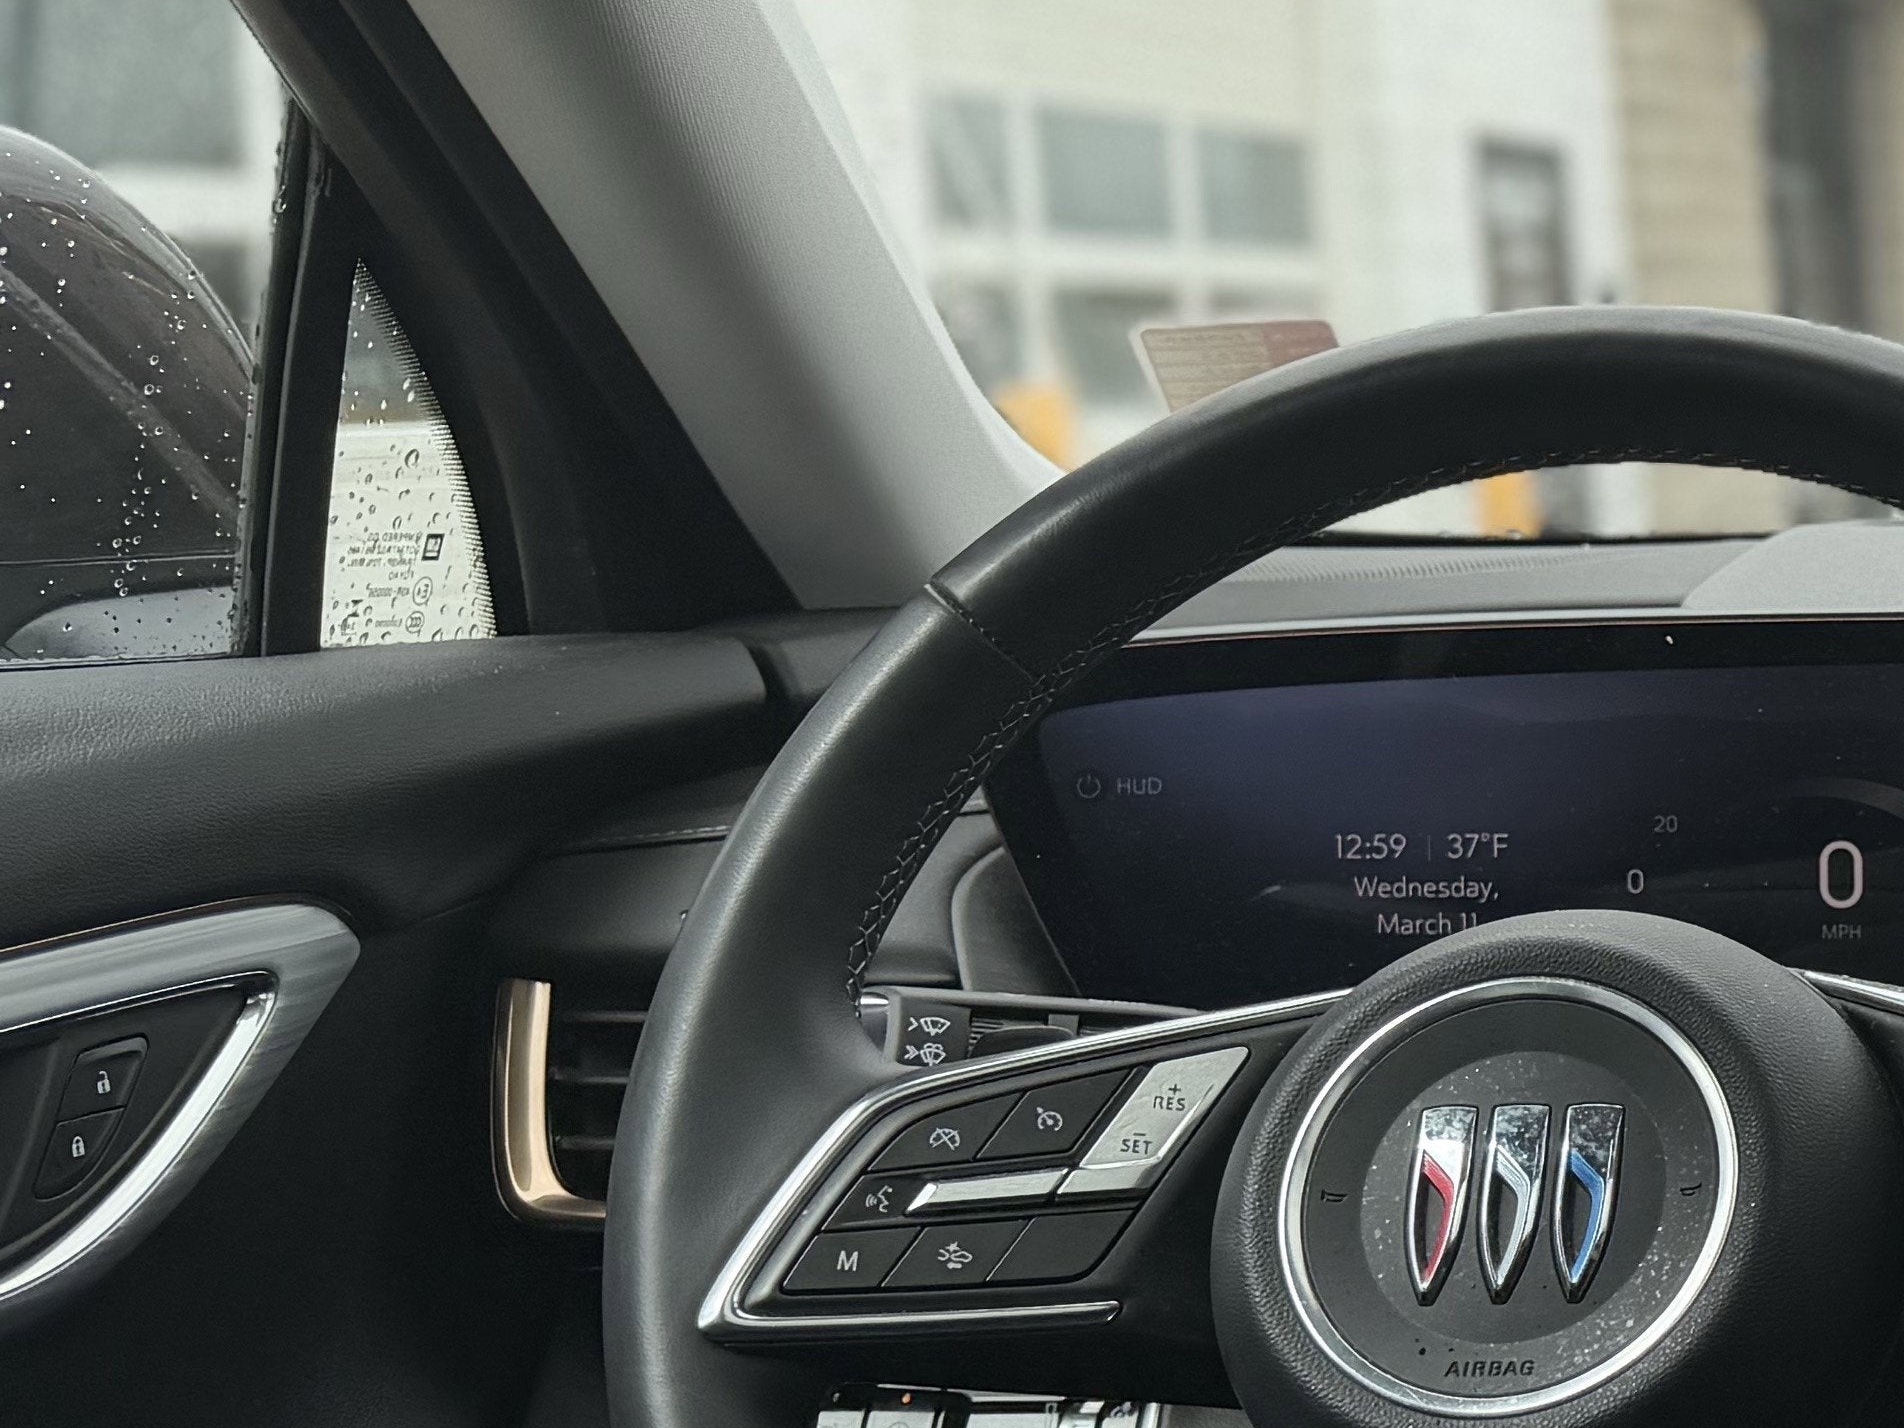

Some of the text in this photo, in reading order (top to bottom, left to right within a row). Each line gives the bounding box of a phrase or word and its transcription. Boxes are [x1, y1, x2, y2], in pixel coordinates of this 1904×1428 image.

[1115, 777, 1163, 795] HUD
[1653, 816, 1679, 833] 20
[1335, 832, 1510, 860] 12:59 37°F
[1626, 868, 1646, 894] 0
[1818, 838, 1865, 909] 0
[1353, 875, 1499, 903] Wednesday,
[1377, 912, 1450, 936] March
[1821, 923, 1862, 940] MPH
[1153, 1095, 1186, 1113] RES
[1120, 1138, 1153, 1155] SET
[836, 1251, 859, 1271] M
[1445, 1360, 1535, 1378] AIRBAG
